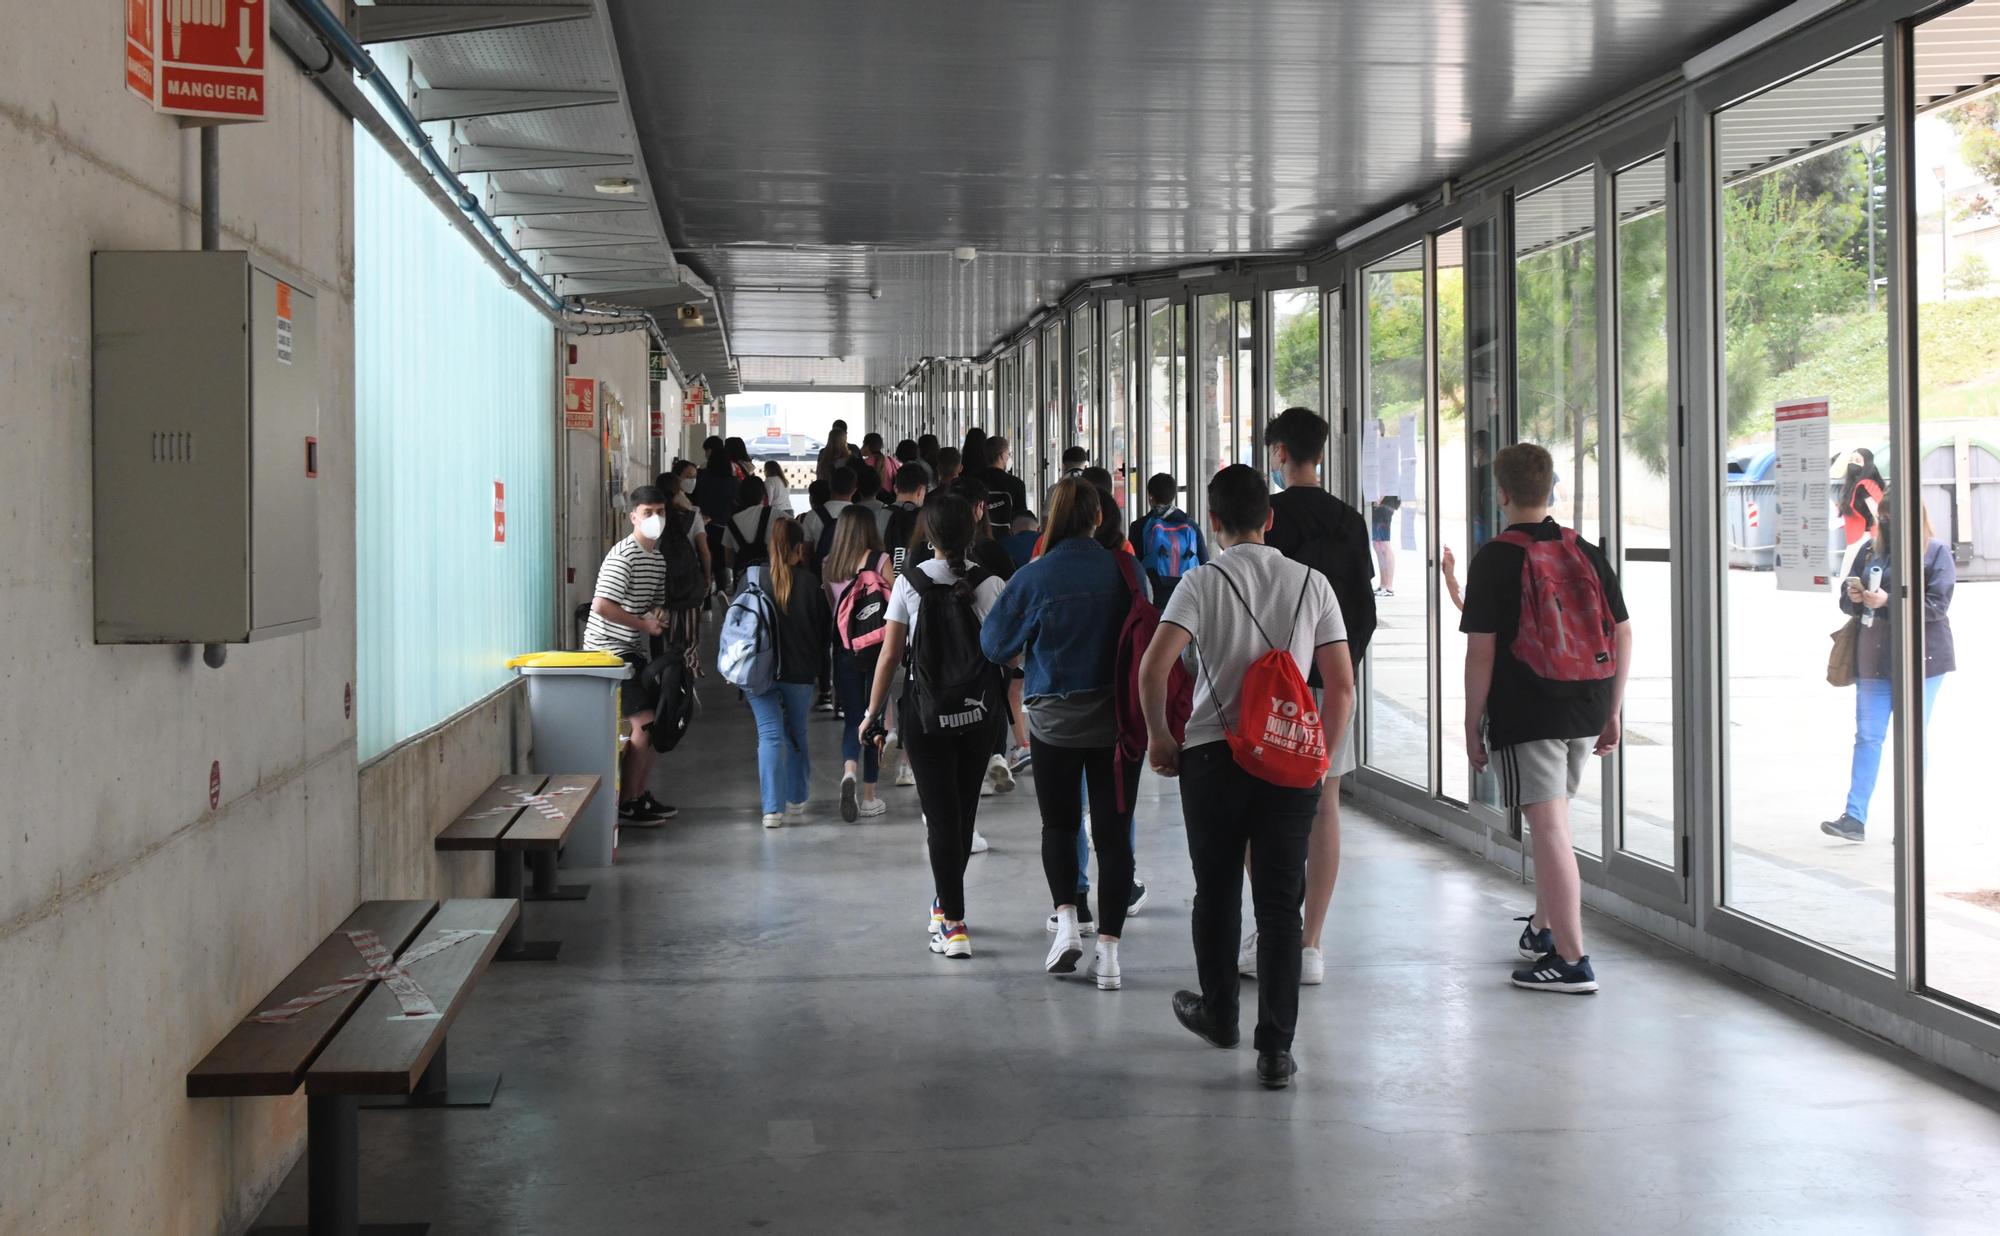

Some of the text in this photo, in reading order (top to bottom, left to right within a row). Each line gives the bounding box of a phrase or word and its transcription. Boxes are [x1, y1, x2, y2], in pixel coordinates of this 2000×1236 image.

[167, 79, 258, 102] MANGUERA
[1271, 696, 1298, 717] YO
[939, 707, 983, 728] PUMA
[1262, 732, 1297, 750] SANGRE
